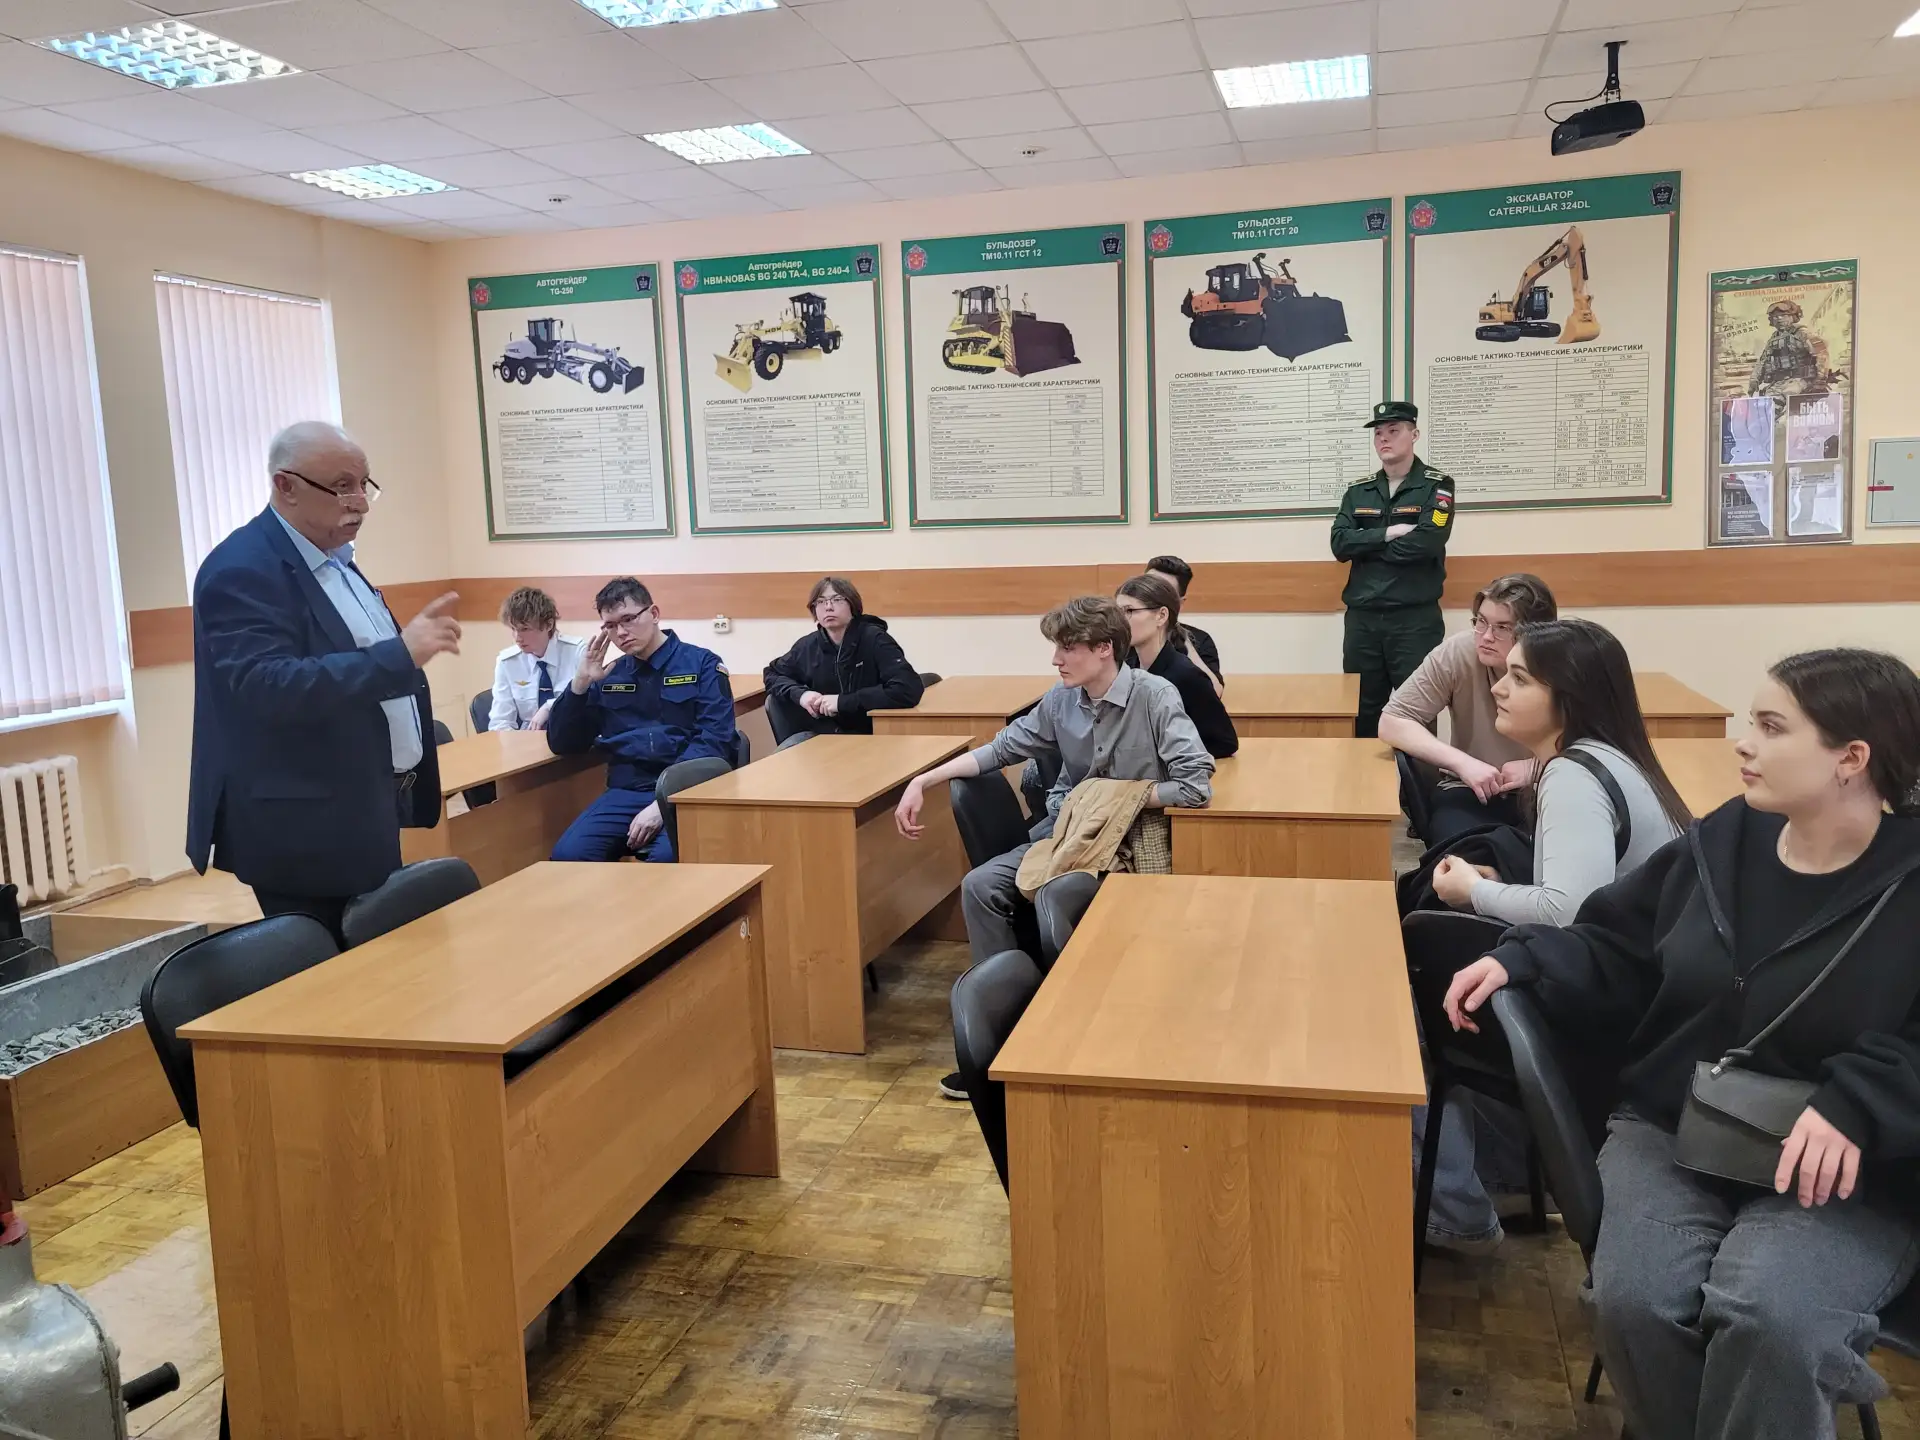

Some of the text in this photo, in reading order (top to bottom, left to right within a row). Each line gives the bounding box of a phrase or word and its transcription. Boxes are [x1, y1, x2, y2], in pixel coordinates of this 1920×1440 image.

[1506, 190, 1574, 204] ЭКСКАВАТОР
[1489, 200, 1590, 216] CATERPILLAR 324DL
[1237, 216, 1292, 228] БУЛЬДОЗЕР
[1232, 226, 1298, 240] ТМ10.11 ГСТ 20
[986, 239, 1036, 250] БУЛЬДОЗЕР
[981, 252, 1012, 260] ТМ10.11
[1014, 250, 1030, 258] ГСТ
[748, 260, 802, 271] Автогрейдер
[536, 276, 588, 288] АВТОГРЕЙДЕР
[704, 274, 756, 286] HBM-NOBAS
[812, 268, 825, 276] BG
[827, 266, 850, 275] 240-4
[550, 286, 574, 296] TG-250
[1435, 344, 1643, 363] ОСНОВНЫЕ ТАКТИКО-ТЕХНИЧЕСКИЕ ХАРАКТЕРИСТИКИ
[1216, 366, 1296, 376] ТАКТИКО-ТЕХНИЧЕСКИЕ
[1298, 362, 1362, 372] ХАРАКТЕРИСТИКИ
[968, 381, 1042, 390] ТАКТИКО-ТЕХНИЧЕСКИЕ
[1042, 378, 1100, 386] ХАРАКТЕРИСТИКИ
